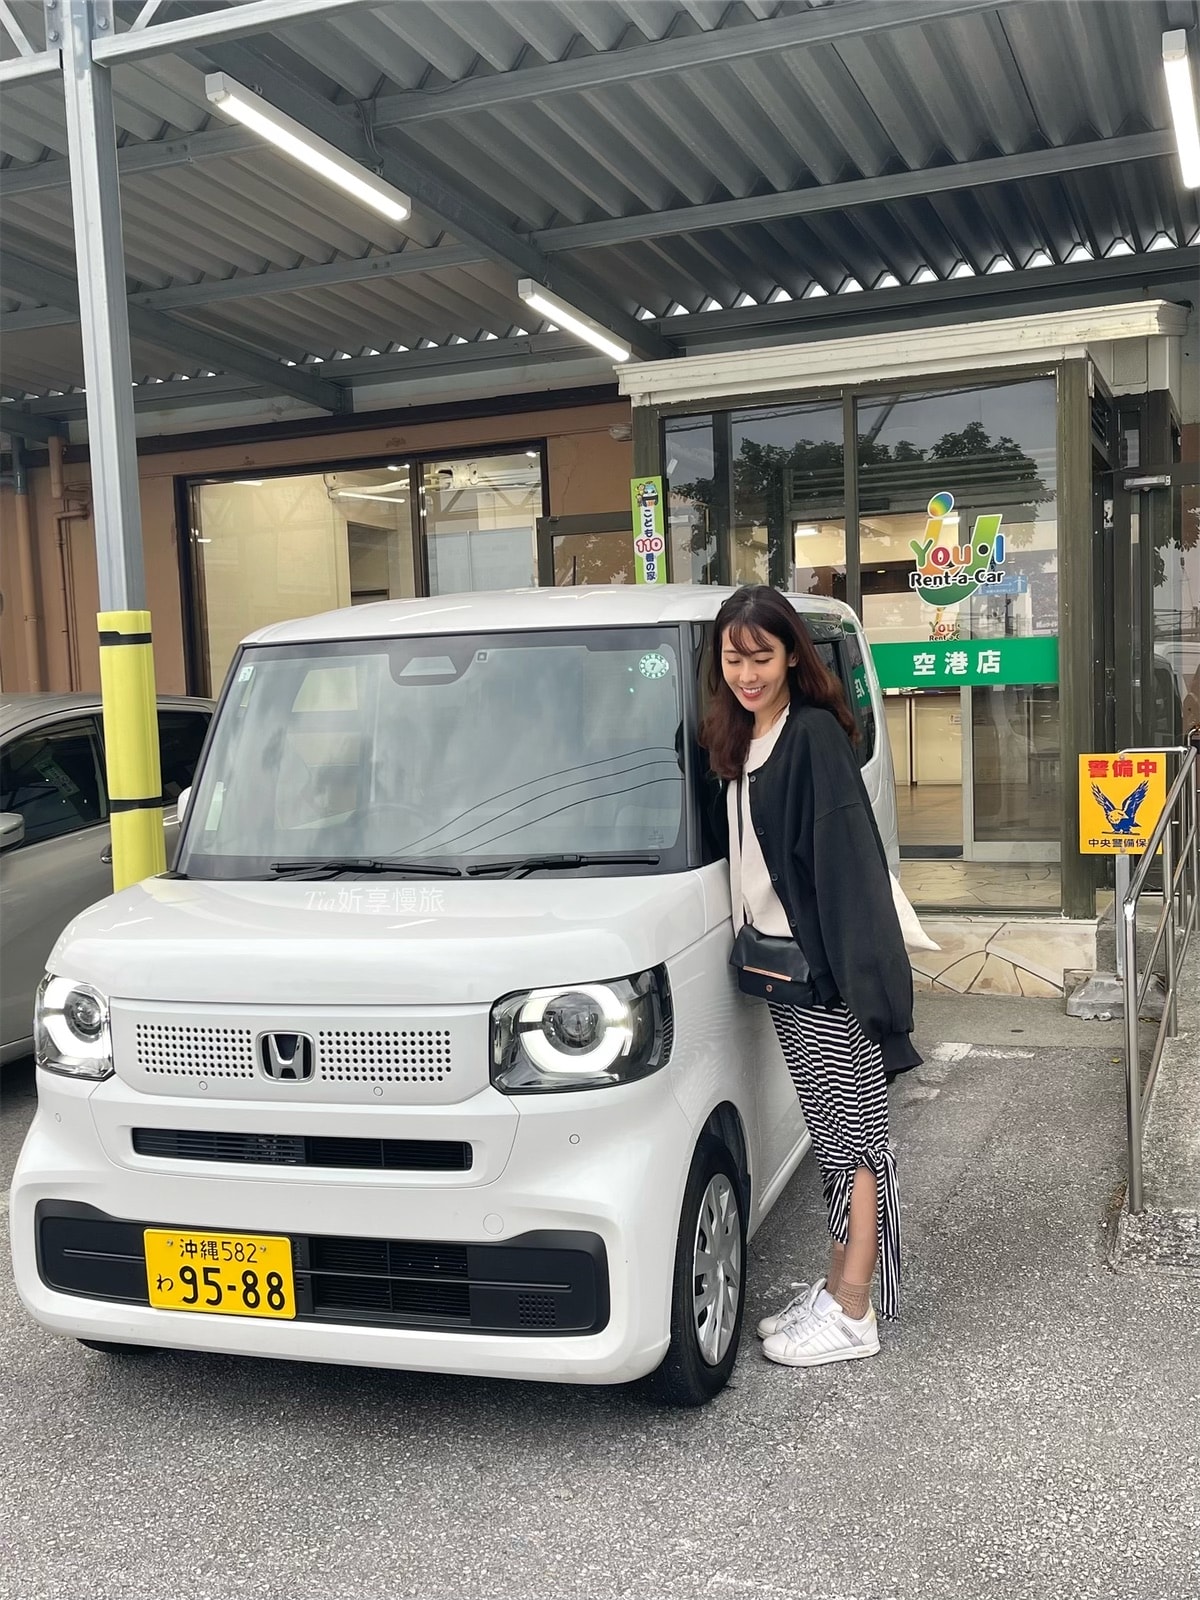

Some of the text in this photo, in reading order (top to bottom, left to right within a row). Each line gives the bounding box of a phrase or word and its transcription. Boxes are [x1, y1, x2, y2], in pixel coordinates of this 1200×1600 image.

[909, 569, 1005, 588] Rent-a-Car
[912, 649, 1001, 676] 空港店
[1088, 759, 1157, 778] 警備中
[1088, 838, 1150, 848] 中央警備保
[156, 1265, 286, 1311] わ 95-88
